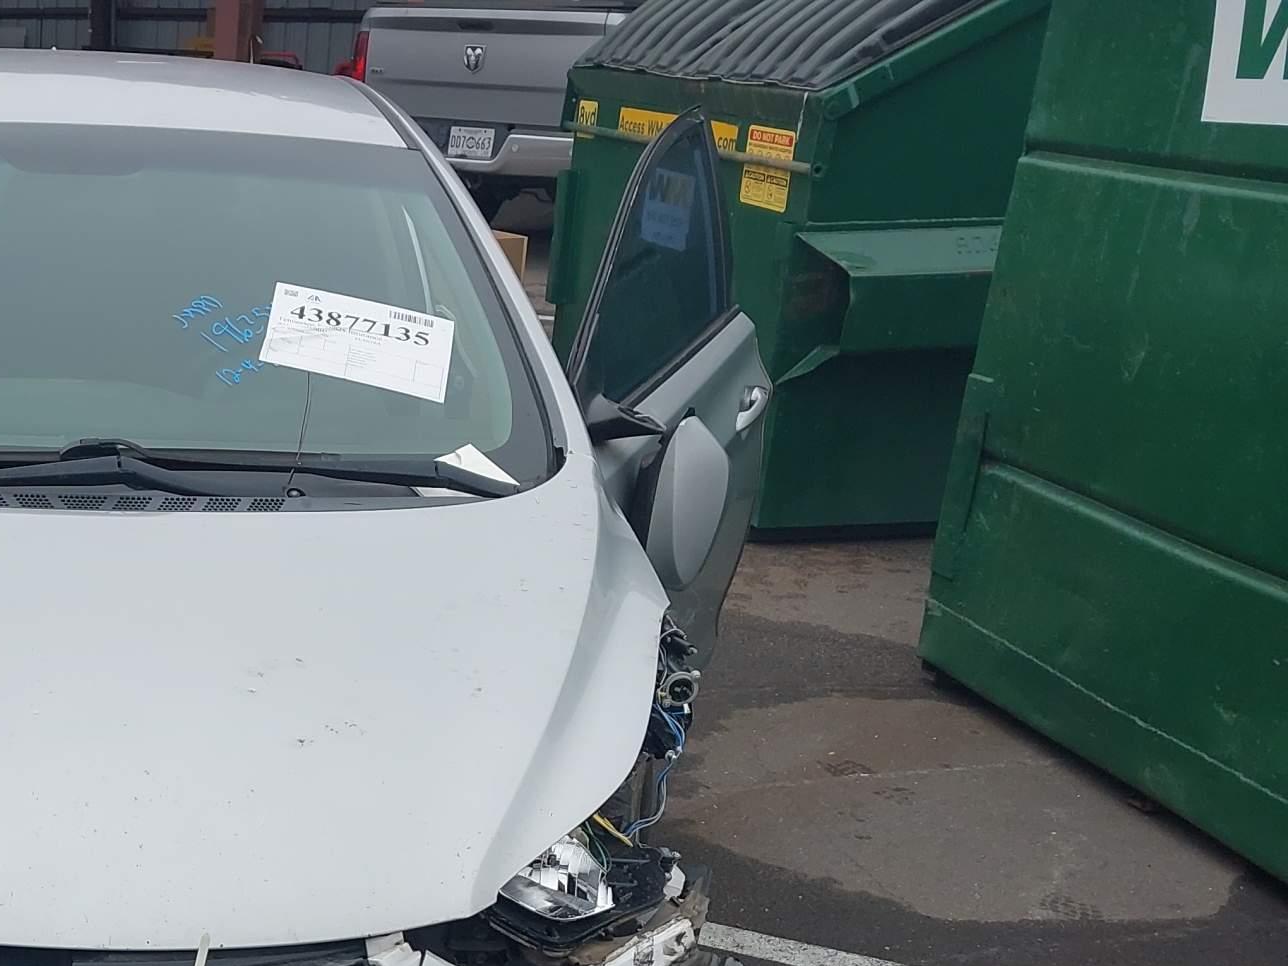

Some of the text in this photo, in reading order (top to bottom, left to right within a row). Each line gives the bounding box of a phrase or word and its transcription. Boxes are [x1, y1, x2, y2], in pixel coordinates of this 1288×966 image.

[620, 115, 645, 136] Access
[753, 130, 791, 146] DO NOT PARK
[290, 305, 431, 347] 43877135
